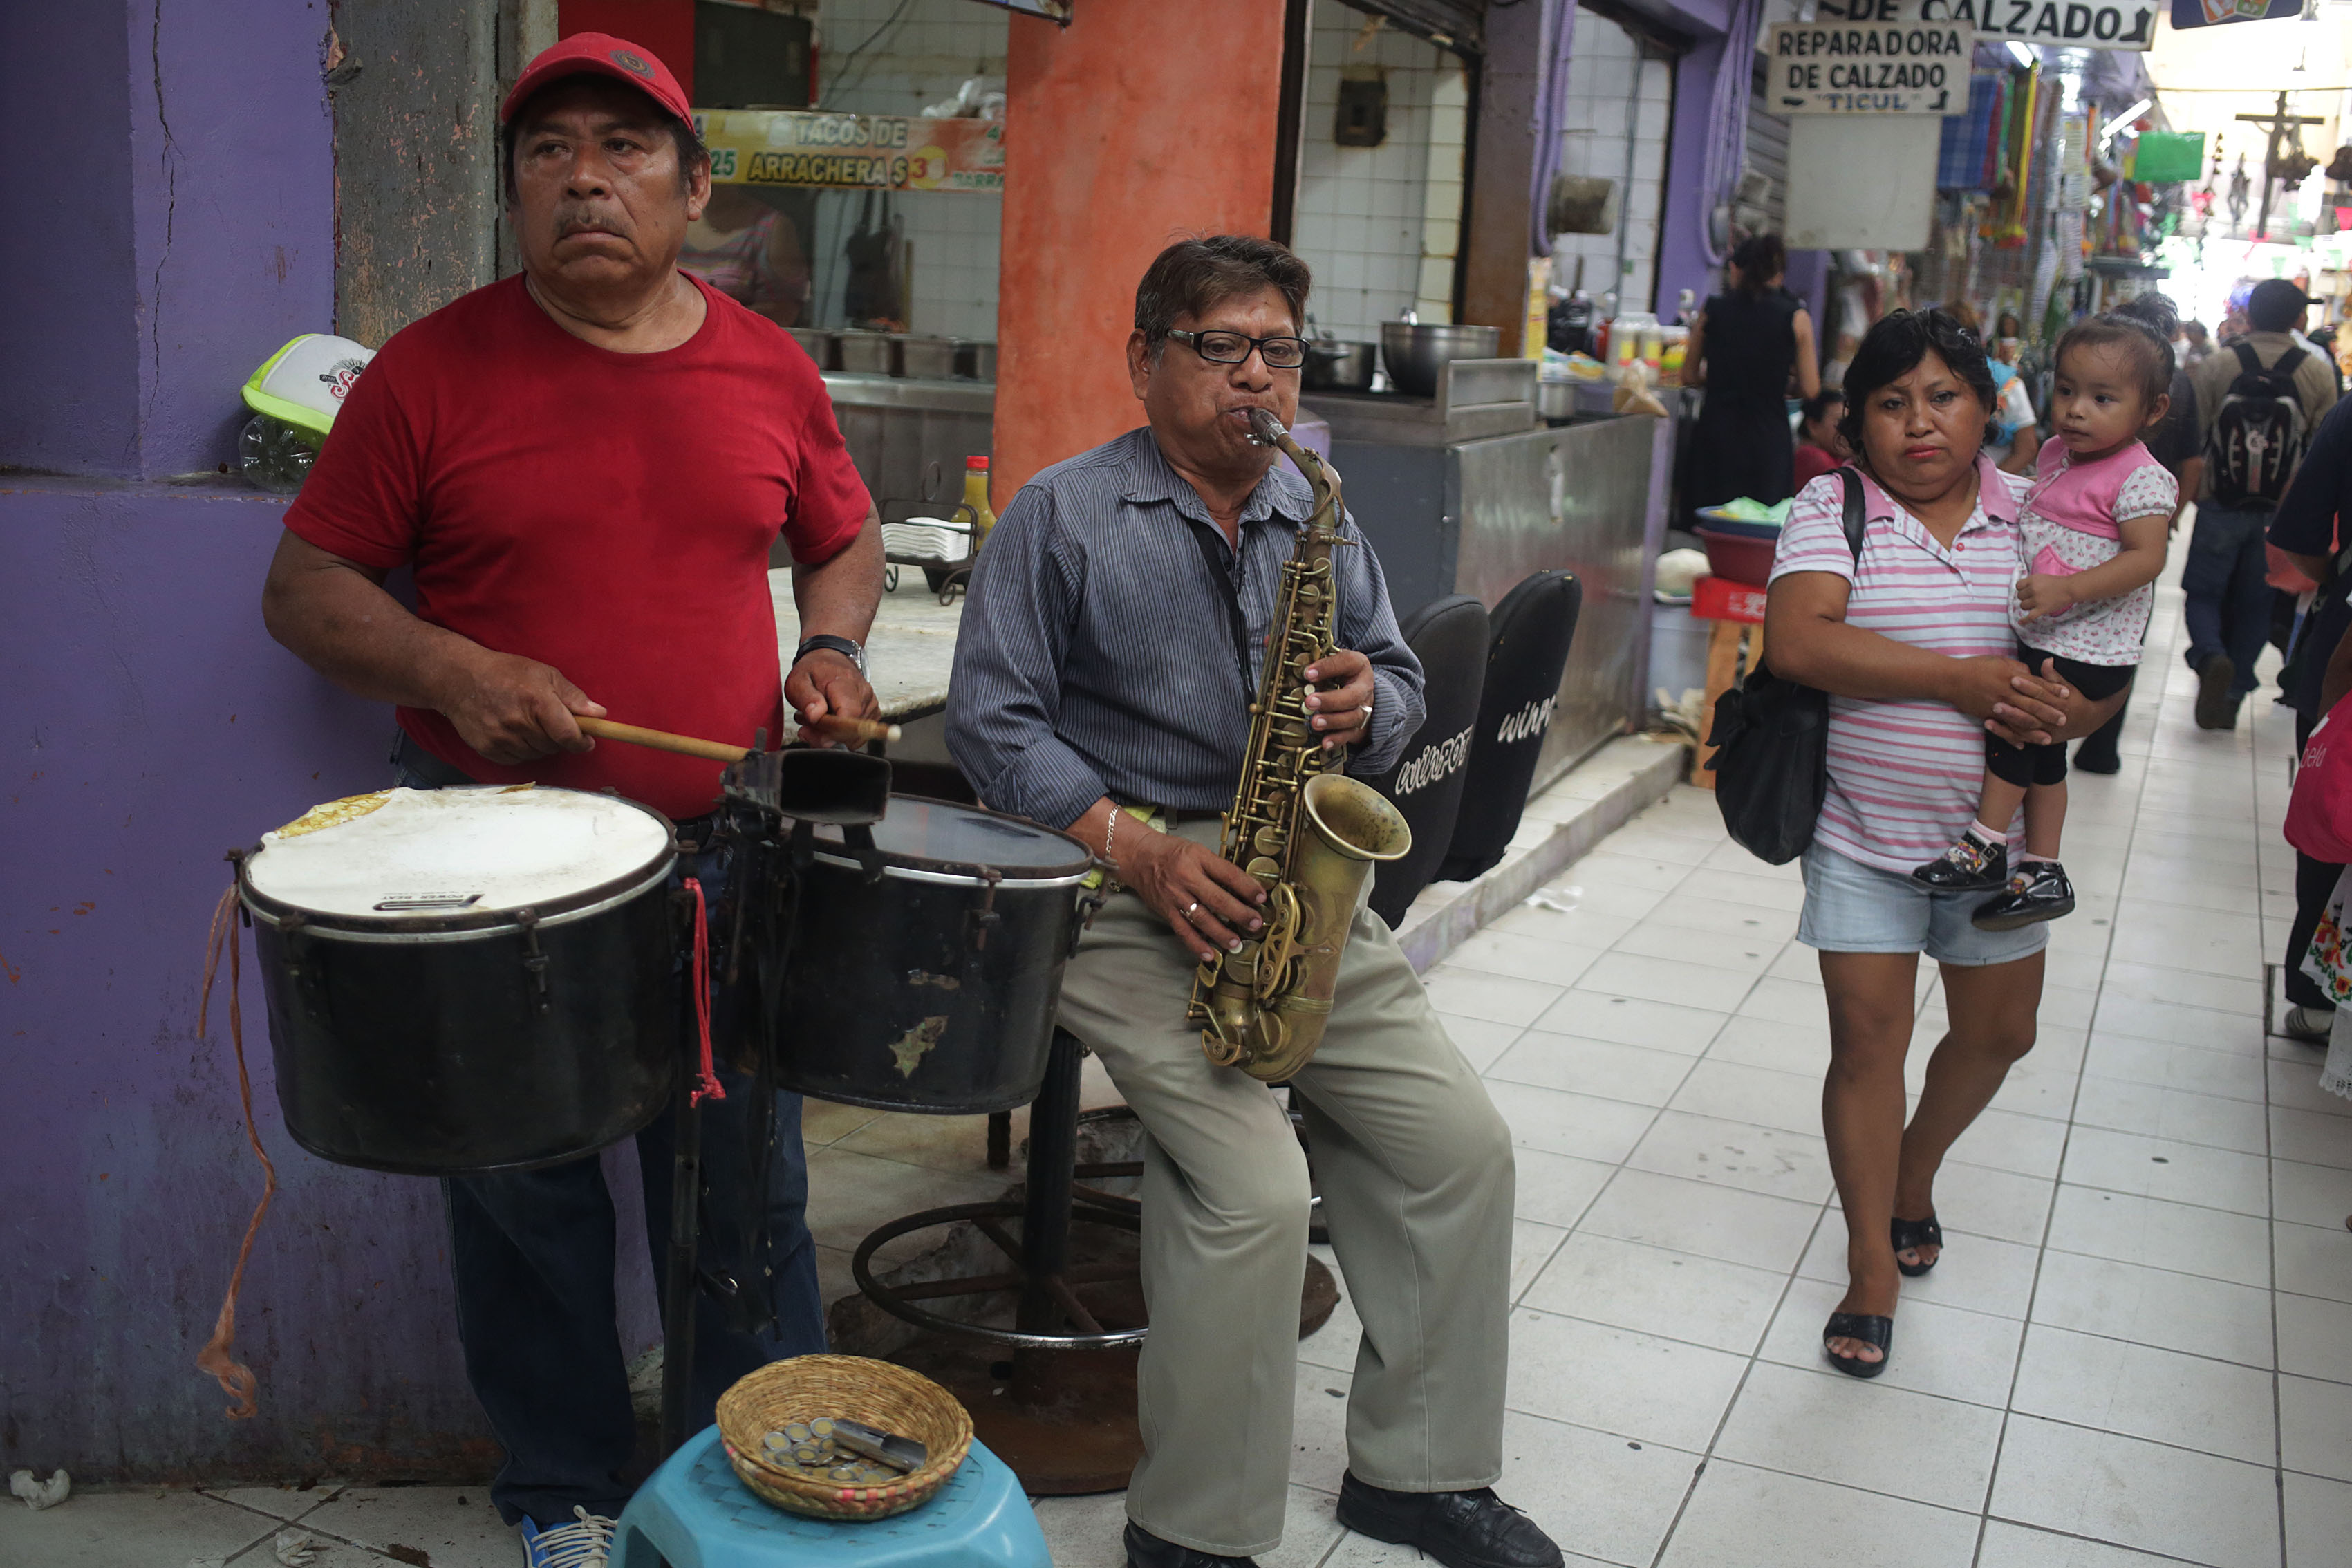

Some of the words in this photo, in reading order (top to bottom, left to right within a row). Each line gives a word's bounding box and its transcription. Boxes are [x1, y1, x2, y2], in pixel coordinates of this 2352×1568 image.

[1921, 0, 2122, 40] CALZADO
[1778, 29, 1961, 55] REPARADORA
[1788, 63, 1820, 88] DE
[1829, 62, 1945, 88] CALZADO
[796, 116, 870, 147] TACOS
[873, 118, 908, 149] DE
[748, 151, 888, 187] ARRACHERA
